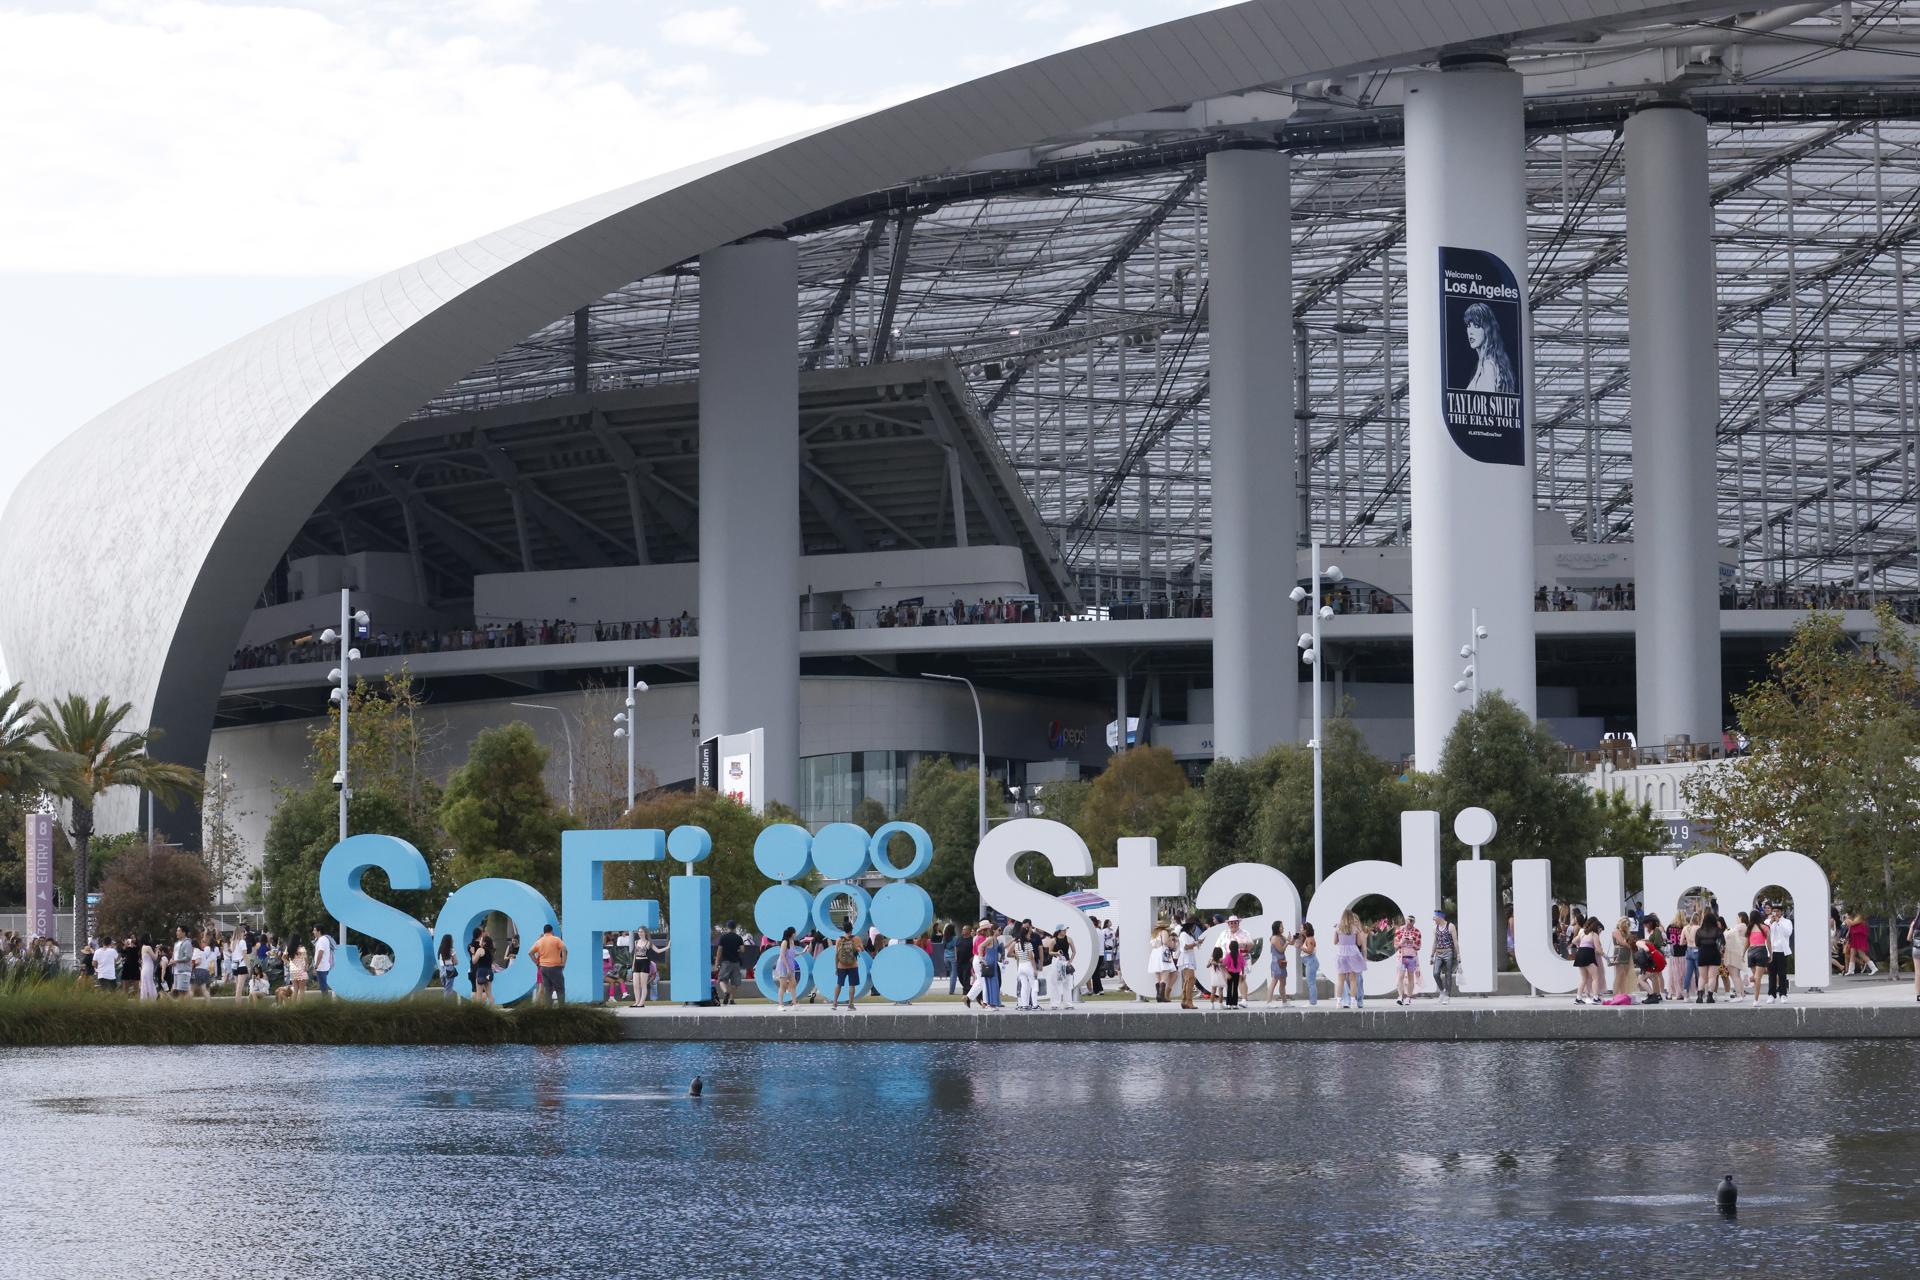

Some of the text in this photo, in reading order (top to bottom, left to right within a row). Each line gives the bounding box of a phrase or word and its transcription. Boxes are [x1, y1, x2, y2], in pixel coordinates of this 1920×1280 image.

[1445, 269, 1482, 281] Welcome to
[1444, 278, 1519, 299] Los Angeles
[1447, 392, 1521, 418] TAYLOR SWIFT
[1447, 413, 1521, 429] THE ERAS TOUR
[702, 748, 710, 787] Stadium
[39, 821, 48, 836] 8
[1681, 825, 1689, 840] 9
[37, 843, 49, 884] ENTRY
[318, 807, 1831, 1006] SoFi Stadium
[37, 908, 47, 938] ZON
